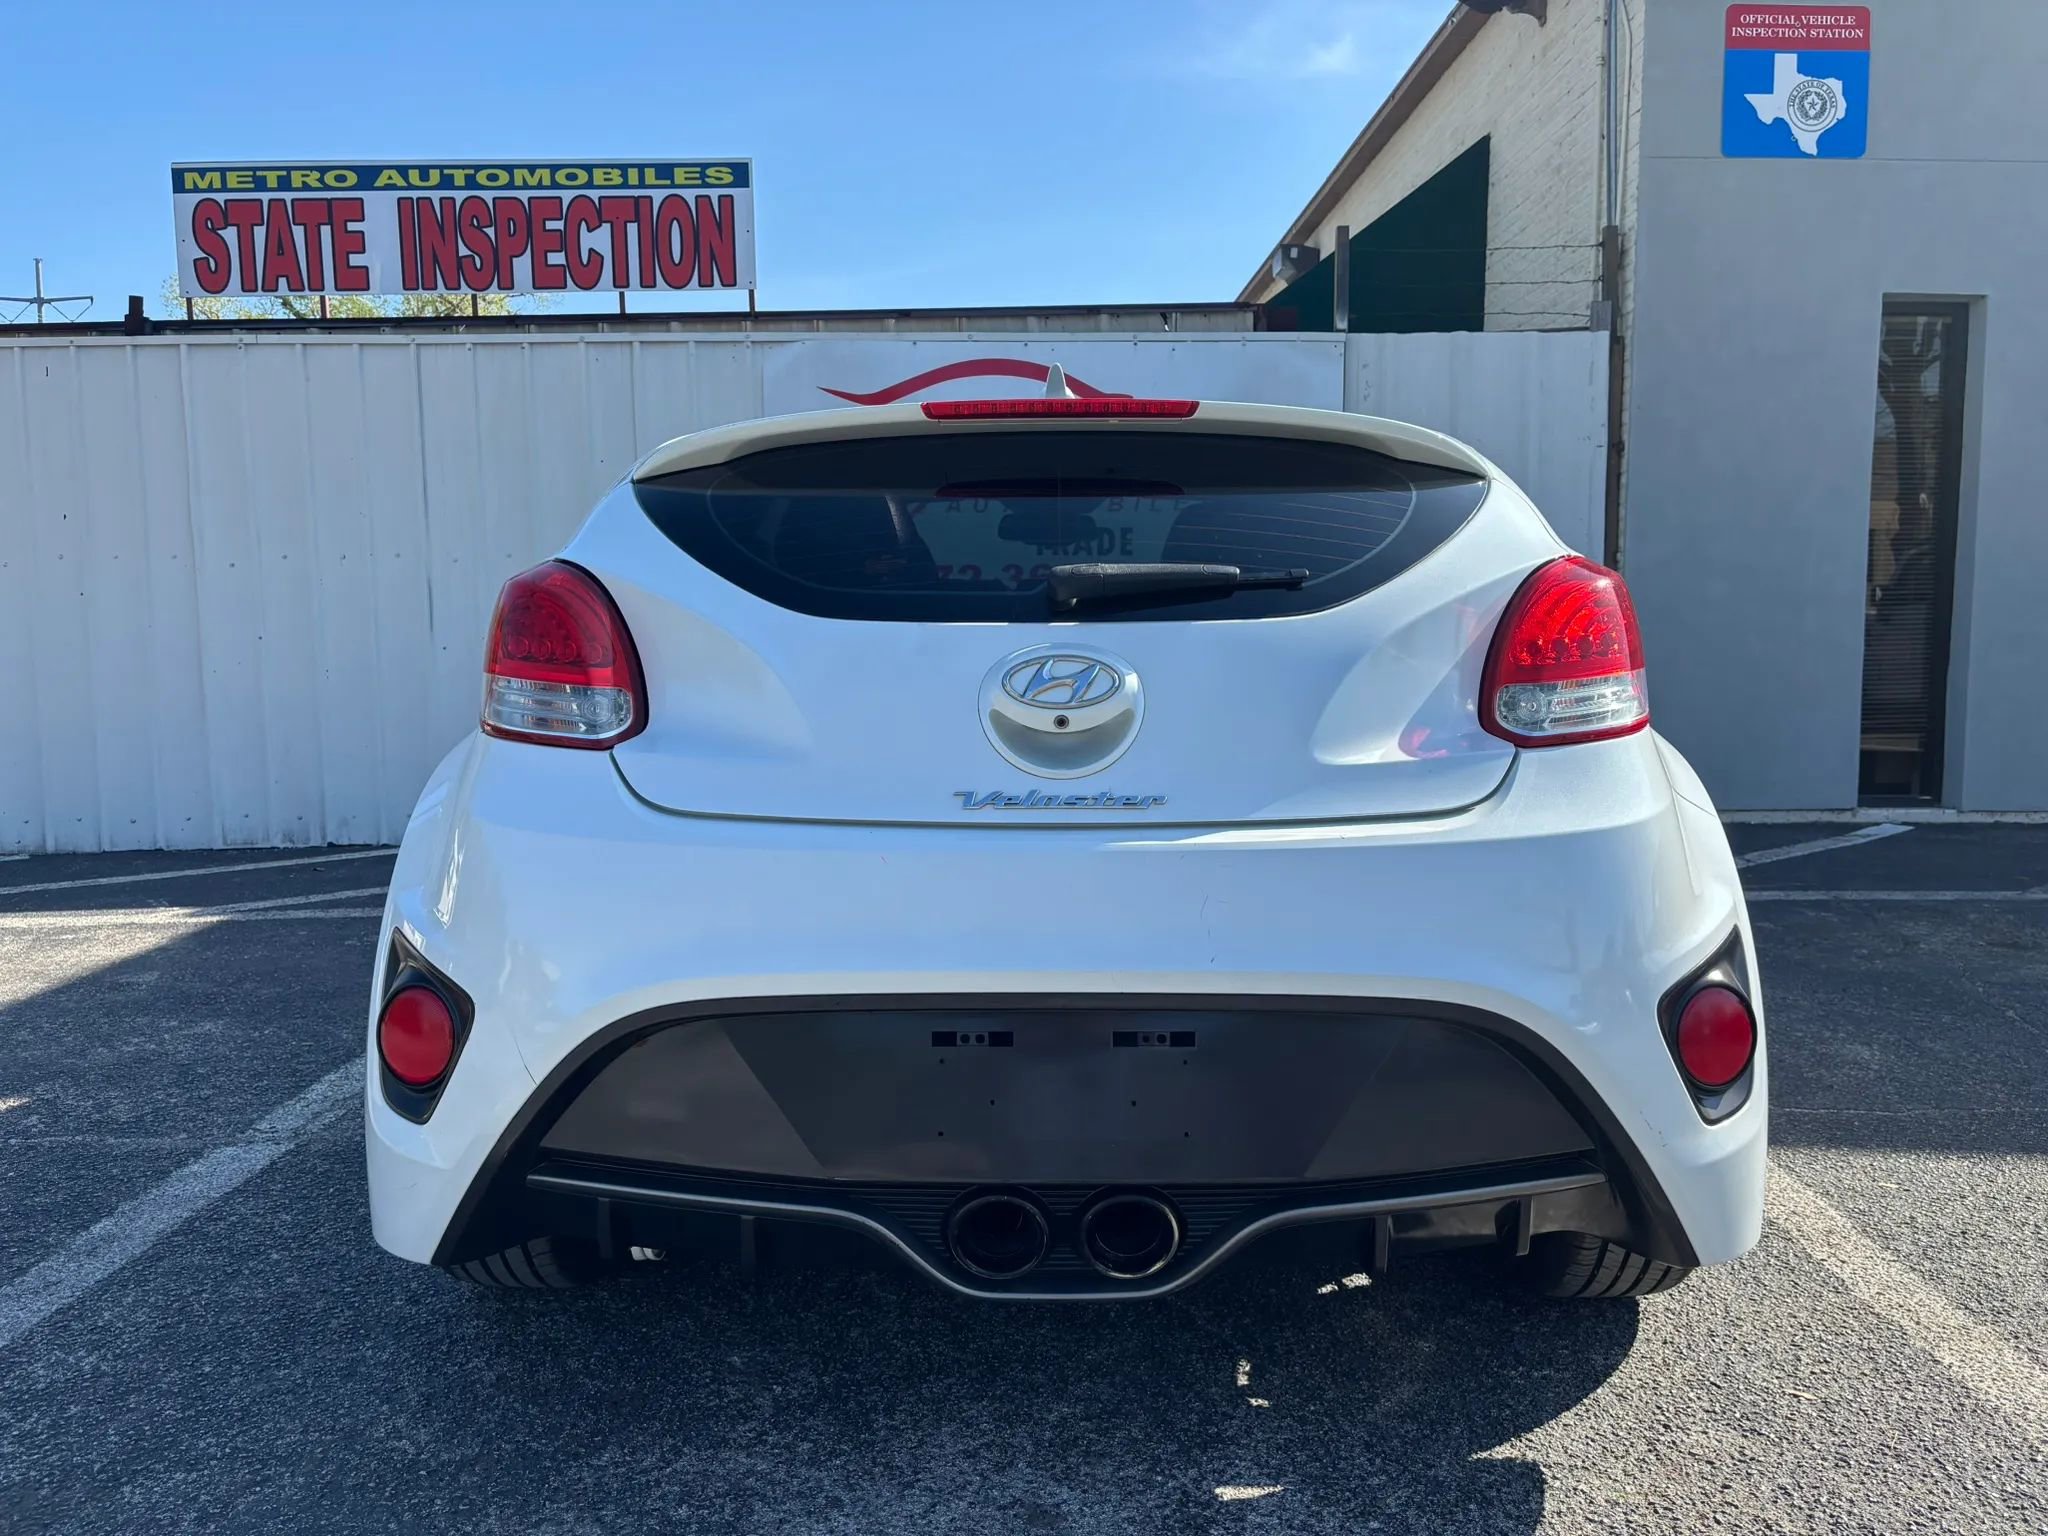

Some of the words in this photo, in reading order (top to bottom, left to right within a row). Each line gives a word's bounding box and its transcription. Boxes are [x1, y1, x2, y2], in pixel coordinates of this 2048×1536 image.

[1740, 14, 1796, 25] OFFICIAL
[1800, 15, 1856, 26] VEHICLE
[1731, 27, 1807, 38] INSPECTION
[1809, 28, 1864, 39] STATION
[183, 169, 358, 190] METRO
[373, 166, 735, 189] AUTOMOBILES
[192, 197, 370, 294] STATE
[396, 194, 738, 291] INSPECTION
[953, 789, 1168, 810] Veloster
